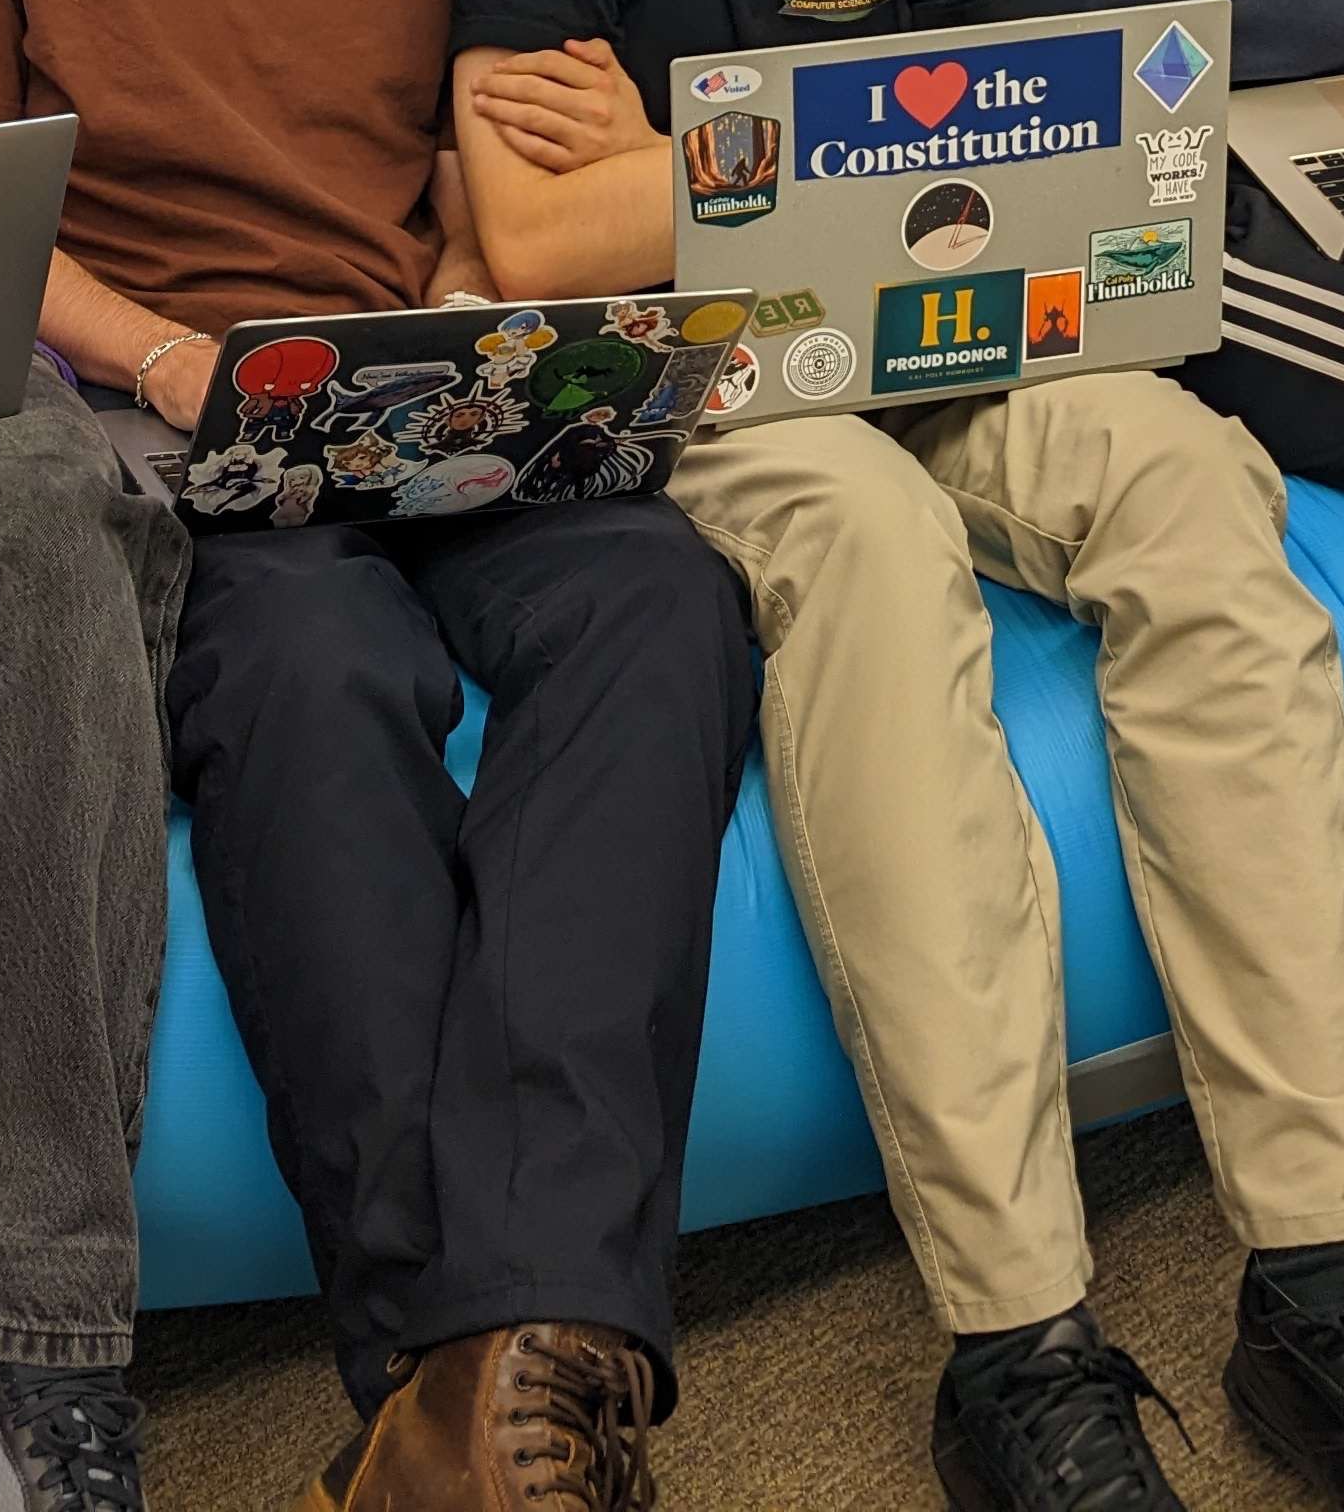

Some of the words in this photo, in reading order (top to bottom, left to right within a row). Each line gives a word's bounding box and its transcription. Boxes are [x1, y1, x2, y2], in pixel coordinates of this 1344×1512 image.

[790, 0, 836, 10] COMPUTER
[724, 84, 751, 94] Voted
[867, 84, 887, 123] I
[973, 68, 1048, 111] the
[810, 115, 1100, 178] Constitution
[1150, 155, 1167, 171] MY
[1172, 151, 1198, 168] CODE
[1150, 163, 1205, 182] WORKS!
[1165, 179, 1189, 195] HAVE
[1087, 270, 1193, 302] Humboldt.
[1105, 276, 1117, 286] Cal
[1117, 274, 1135, 285] Poly
[803, 337, 819, 348] THE
[822, 337, 846, 358] WORLD
[886, 354, 944, 373] PROUD
[946, 345, 1007, 365] DONOR
